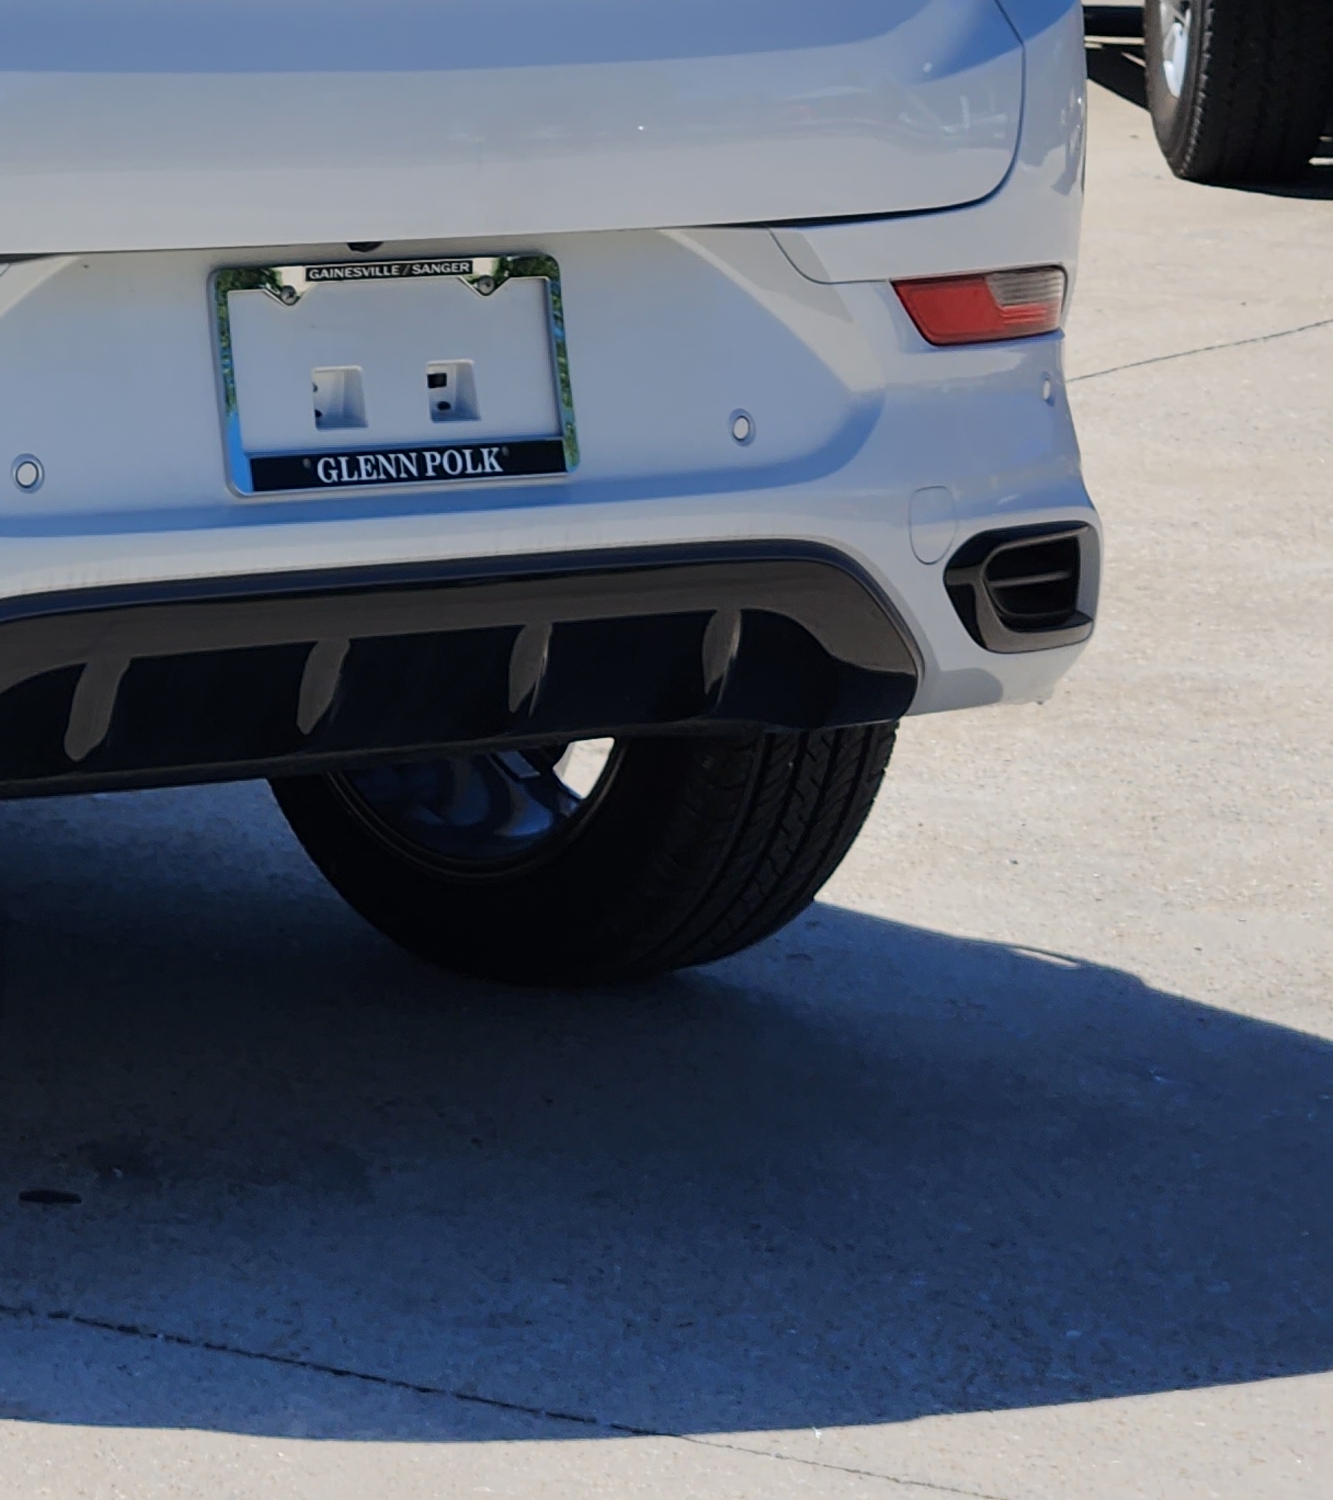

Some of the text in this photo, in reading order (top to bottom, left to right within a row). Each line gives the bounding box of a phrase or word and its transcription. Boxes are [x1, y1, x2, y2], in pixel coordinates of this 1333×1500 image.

[308, 265, 400, 280] GAINESVILLE
[412, 262, 470, 275] SANGER
[317, 447, 504, 484] GLENN POLK
